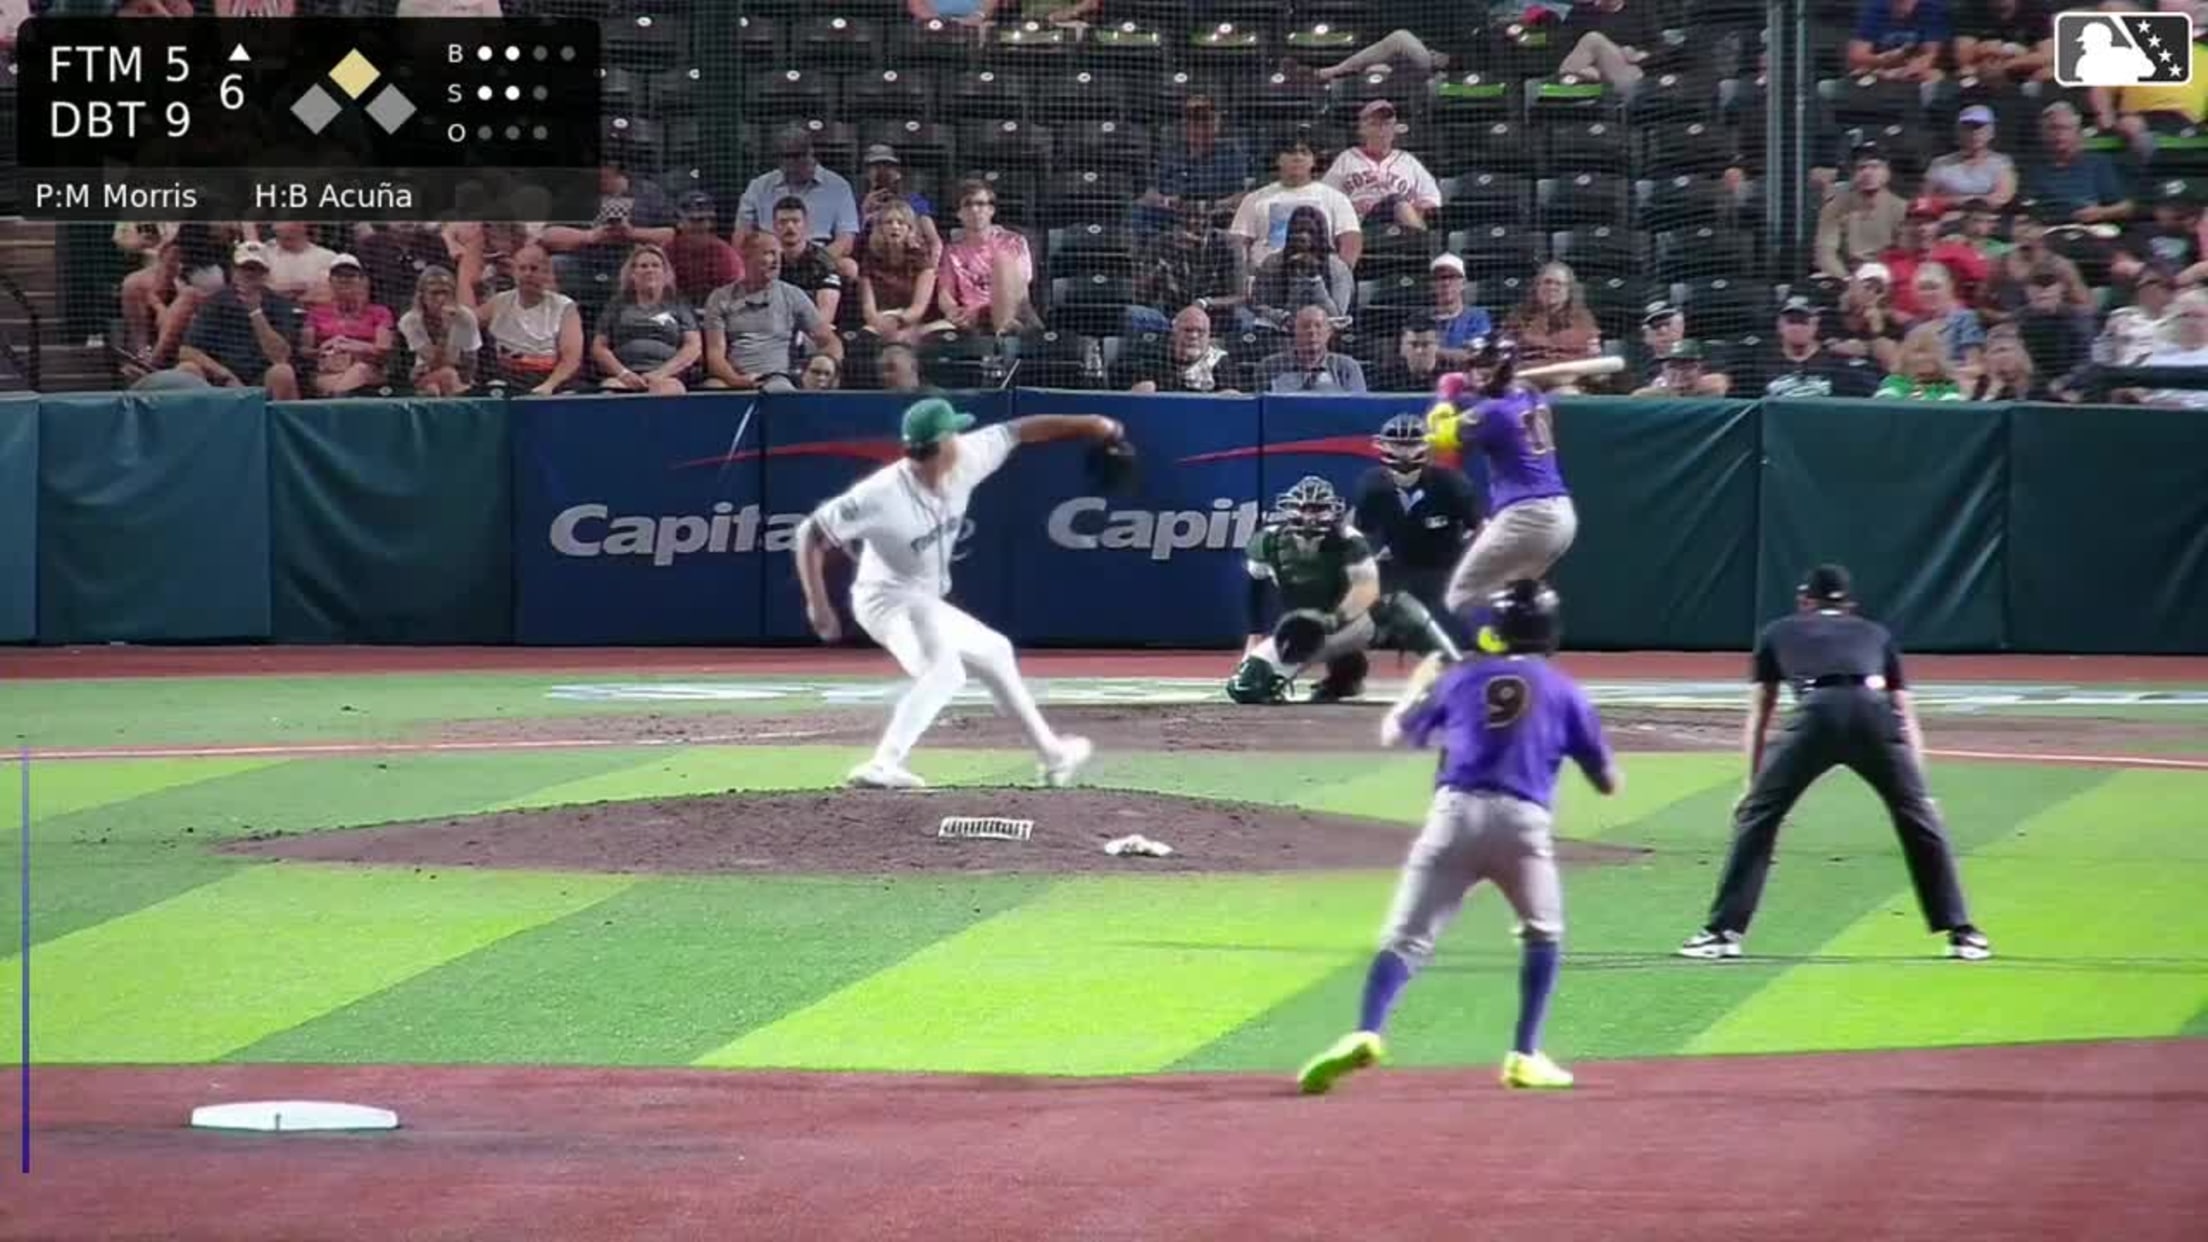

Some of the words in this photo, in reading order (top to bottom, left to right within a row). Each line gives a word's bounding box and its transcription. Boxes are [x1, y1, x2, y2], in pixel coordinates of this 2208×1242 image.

[549, 502, 801, 566] Capita
[1048, 497, 1284, 560] Capit
[1484, 675, 1530, 728] 9
